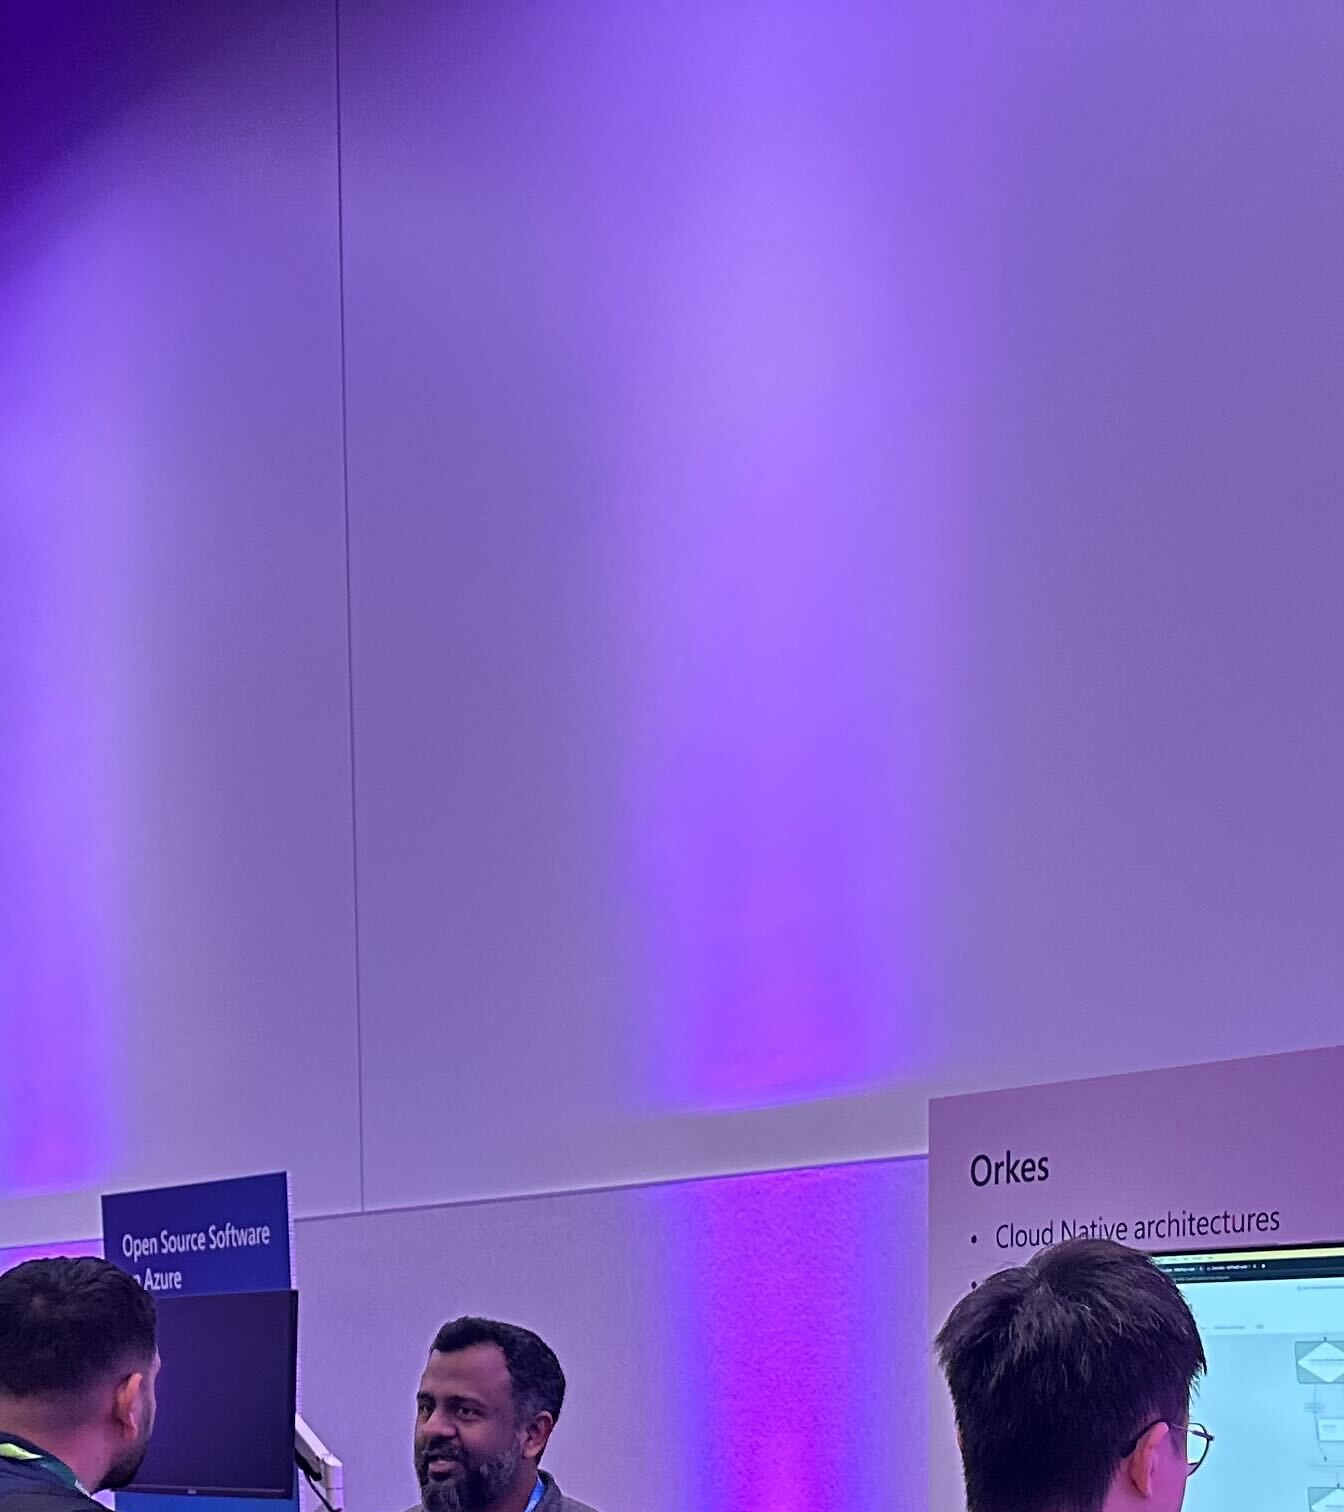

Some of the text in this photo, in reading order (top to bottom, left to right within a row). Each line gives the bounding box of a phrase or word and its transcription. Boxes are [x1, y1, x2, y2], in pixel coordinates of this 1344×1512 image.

[970, 1150, 1050, 1187] Orkes
[122, 1222, 271, 1261] Open Source Software
[996, 1208, 1281, 1250] Cloud Native architectures
[144, 1267, 183, 1290] Azure
